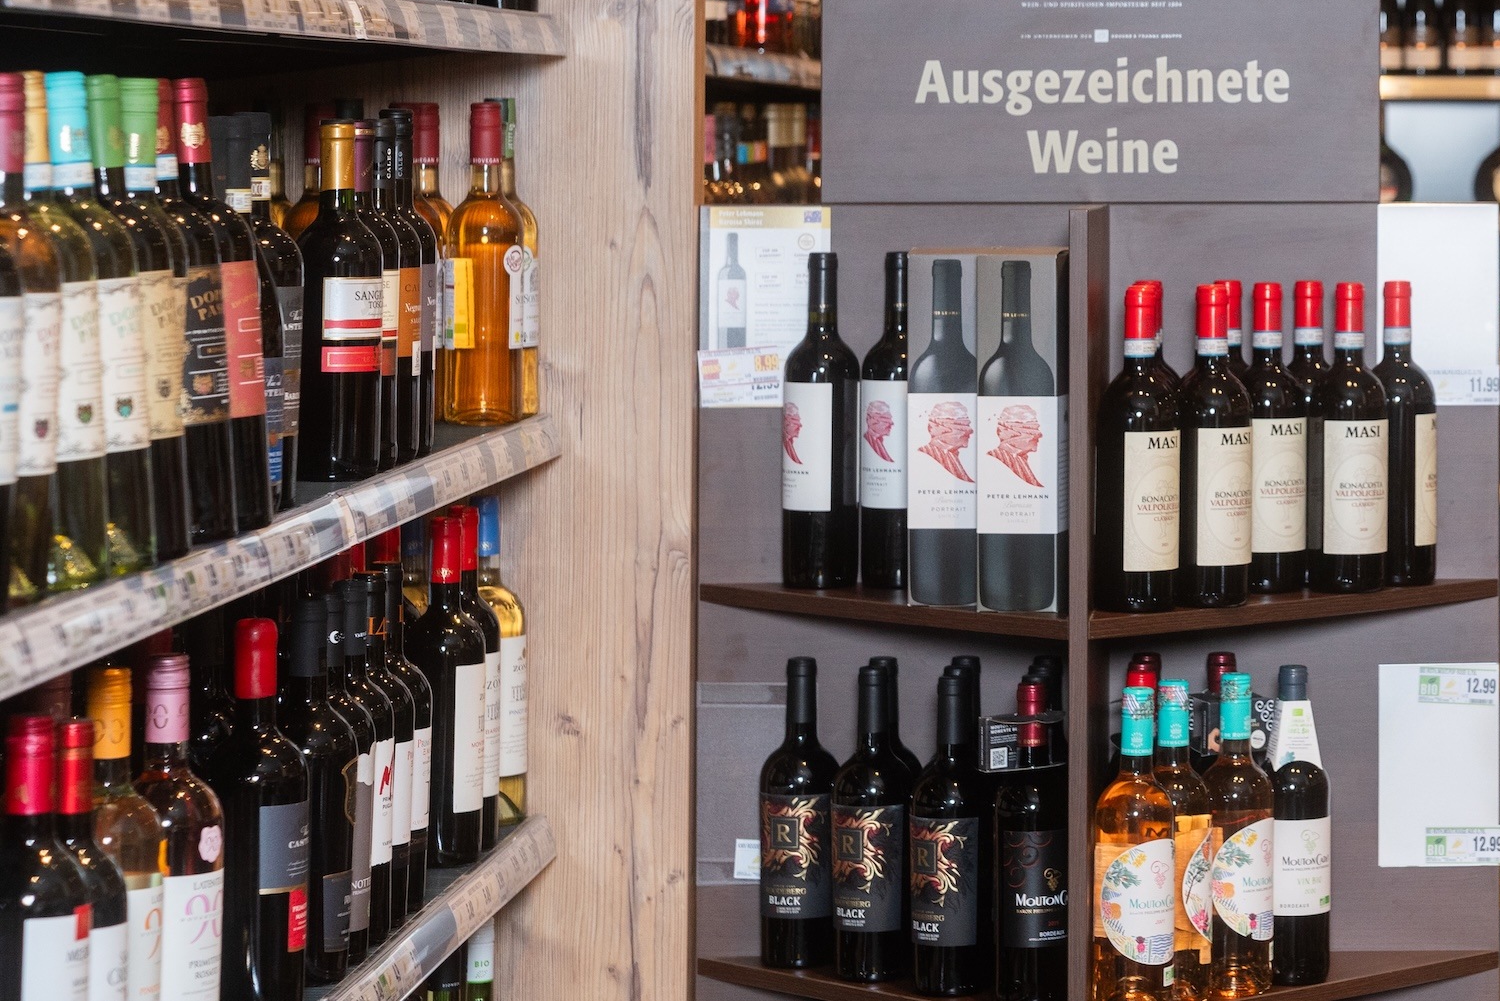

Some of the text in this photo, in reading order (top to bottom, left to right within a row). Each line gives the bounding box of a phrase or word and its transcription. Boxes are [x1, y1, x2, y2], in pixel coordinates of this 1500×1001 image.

[915, 56, 1290, 116] Ausgezeichnete
[1026, 127, 1179, 174] Weine
[754, 354, 780, 373] 8.99
[1470, 376, 1500, 393] 11.99
[1270, 423, 1303, 436] MASI
[1345, 425, 1381, 439] MASI
[1147, 435, 1178, 450] MASI
[1339, 481, 1383, 489] BONACOSTA
[1335, 489, 1385, 498] VALPOLICELLA
[1420, 683, 1438, 695] BIO
[1466, 677, 1497, 694] 12.99
[776, 823, 793, 843] R
[842, 835, 856, 855] R
[1427, 844, 1445, 856] BIO
[917, 847, 931, 867] R
[768, 895, 801, 906] BLACK
[836, 906, 866, 919] BLACK
[912, 920, 940, 933] BLACK
[474, 960, 490, 968] BIO
